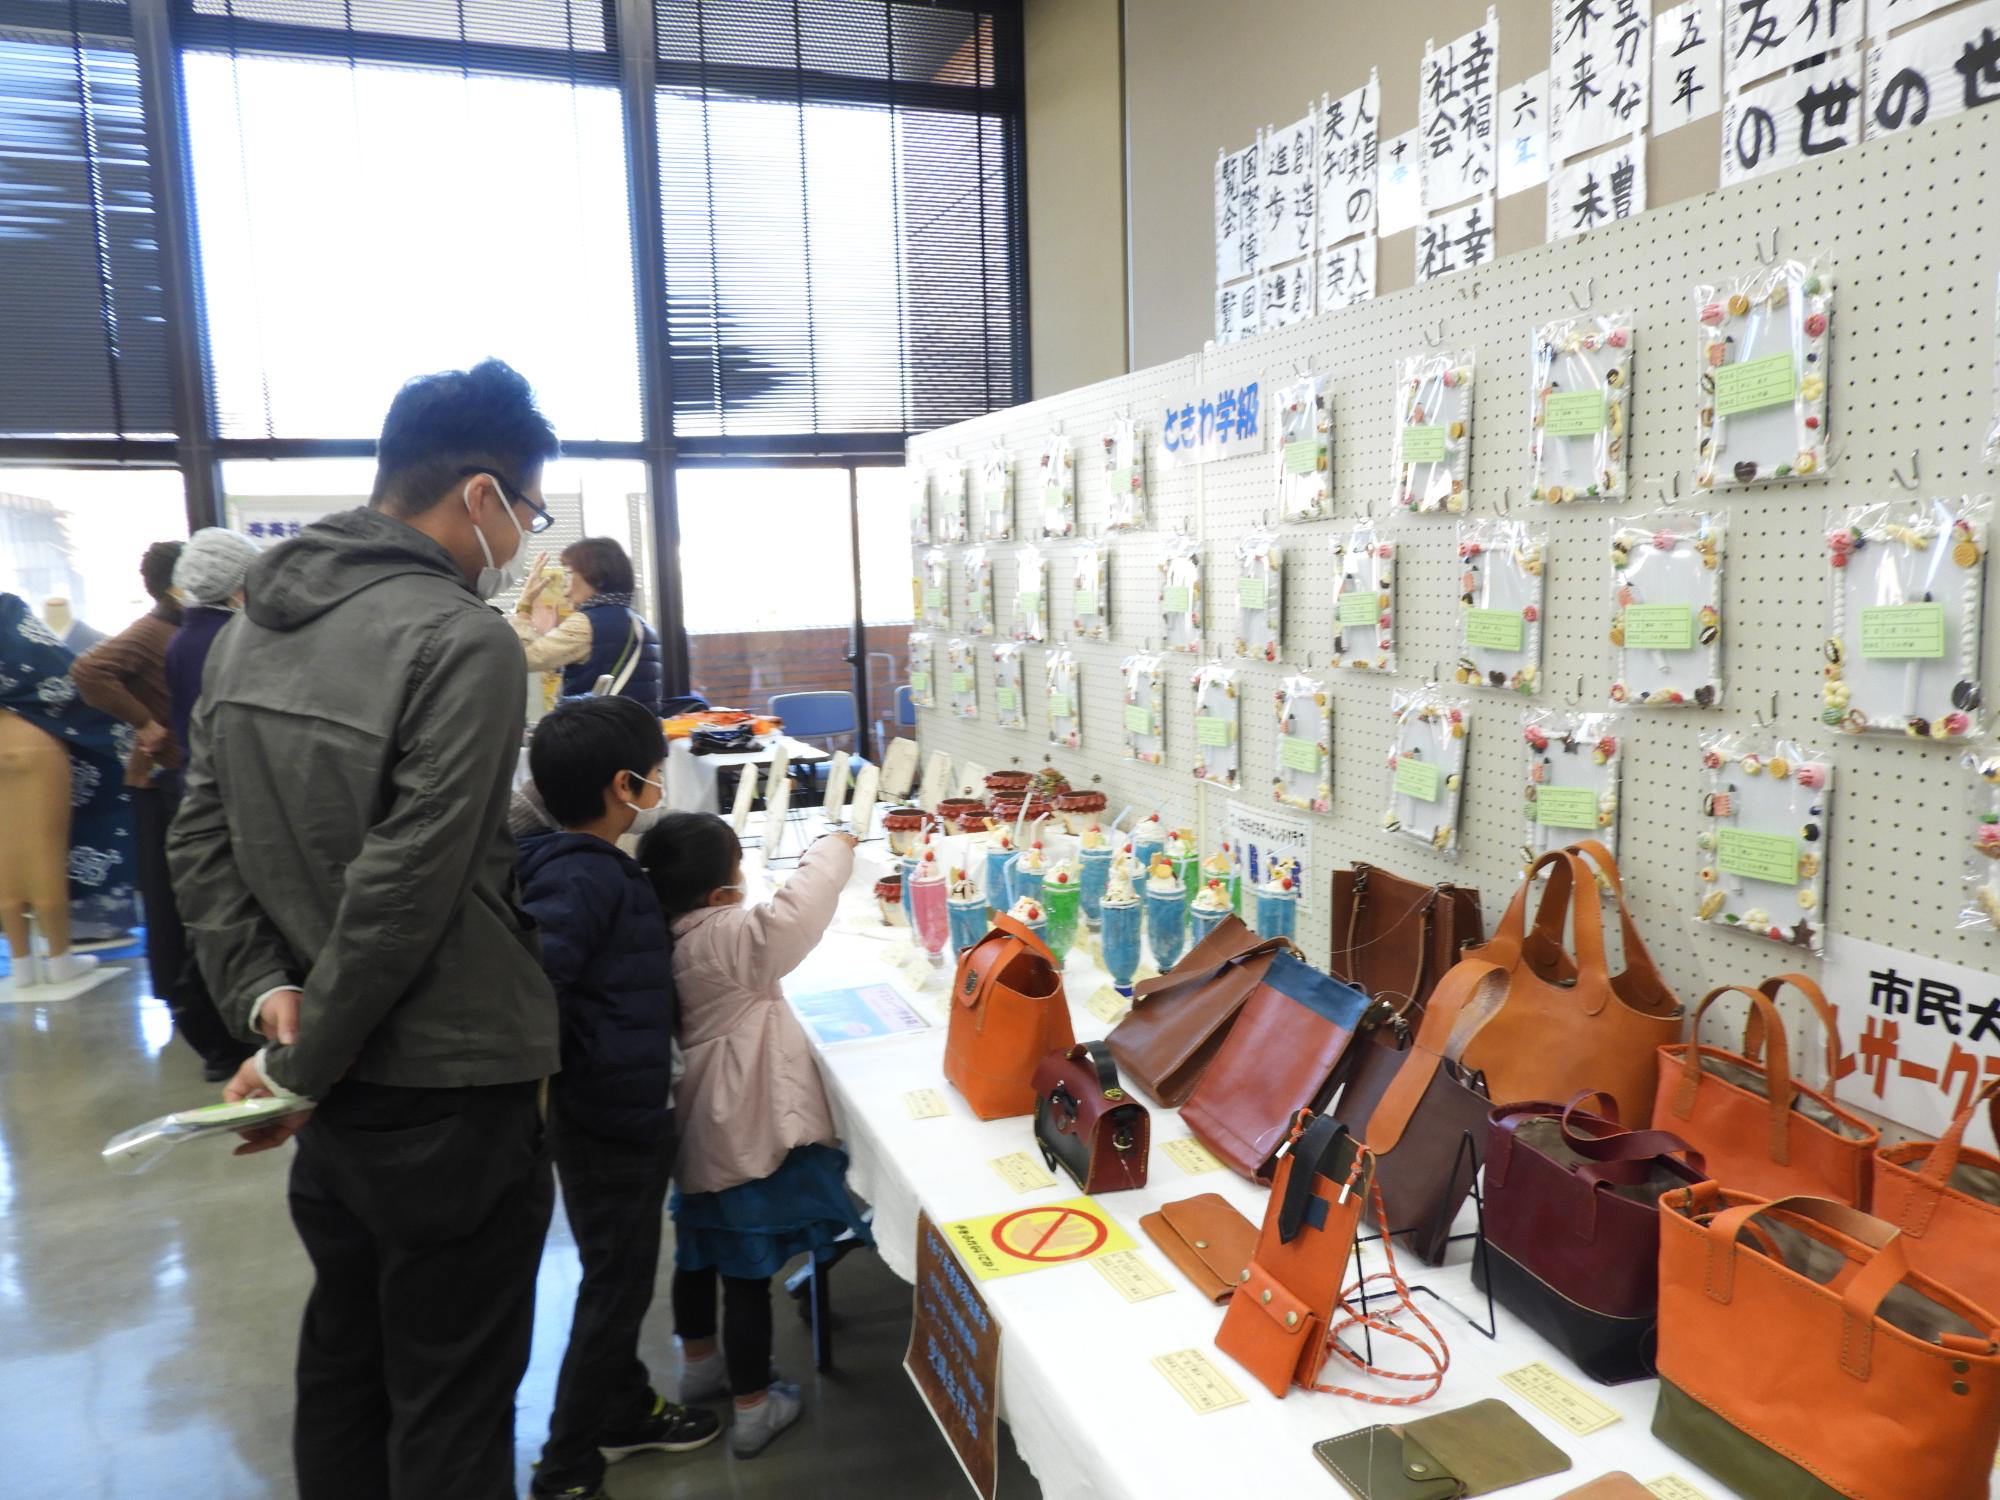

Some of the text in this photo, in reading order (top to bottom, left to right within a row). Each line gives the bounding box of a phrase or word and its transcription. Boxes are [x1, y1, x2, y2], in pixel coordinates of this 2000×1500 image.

[1671, 10, 1708, 115] 五年
[1426, 45, 1461, 160] 社会
[1459, 29, 1494, 185] 幸福な
[1797, 76, 1861, 157] 世
[1875, 67, 1930, 130] の
[1736, 106, 1777, 170] の
[1419, 222, 1456, 280] 社
[1453, 206, 1492, 267] 幸
[1345, 246, 1372, 307] 人
[1163, 380, 1260, 454] ときわ学級
